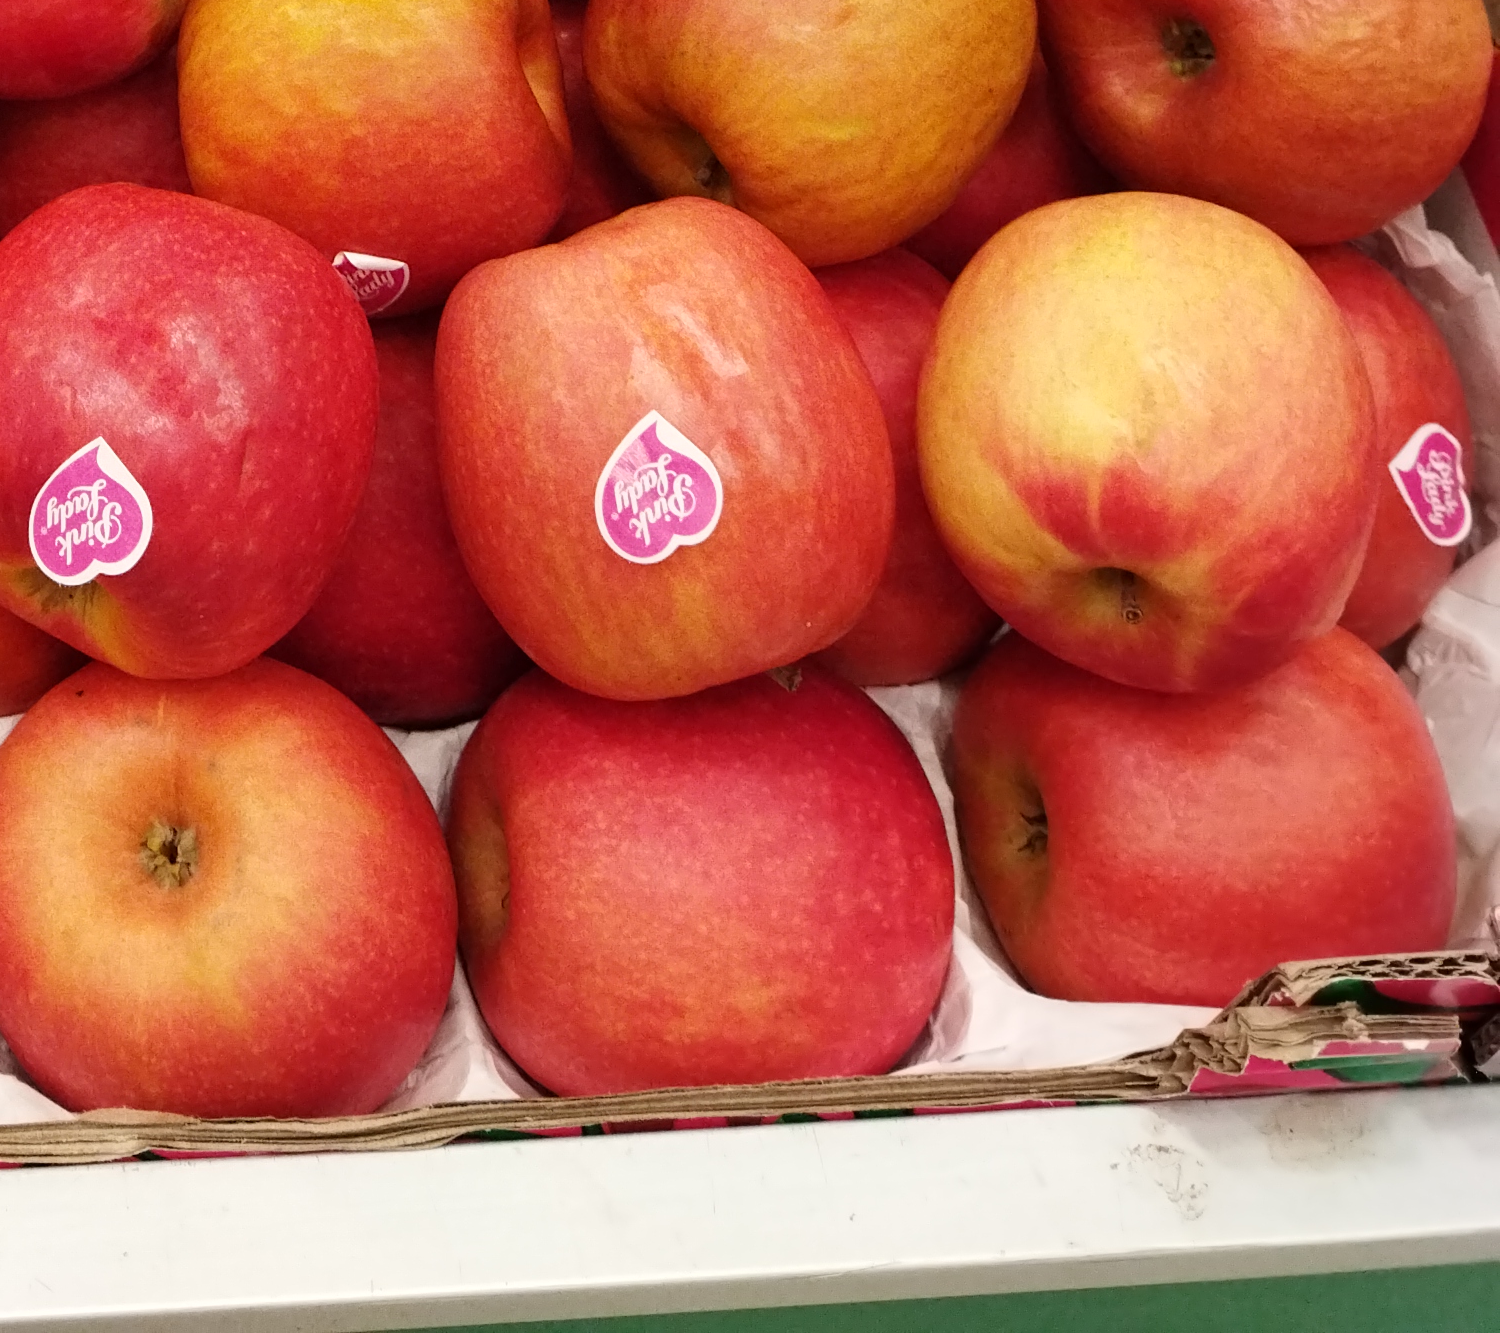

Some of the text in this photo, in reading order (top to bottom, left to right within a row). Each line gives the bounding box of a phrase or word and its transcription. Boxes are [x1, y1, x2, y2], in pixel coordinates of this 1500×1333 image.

[46, 478, 109, 534] Lady
[614, 453, 678, 515] Lady
[628, 473, 697, 548] Pink
[54, 501, 123, 566] Pink
